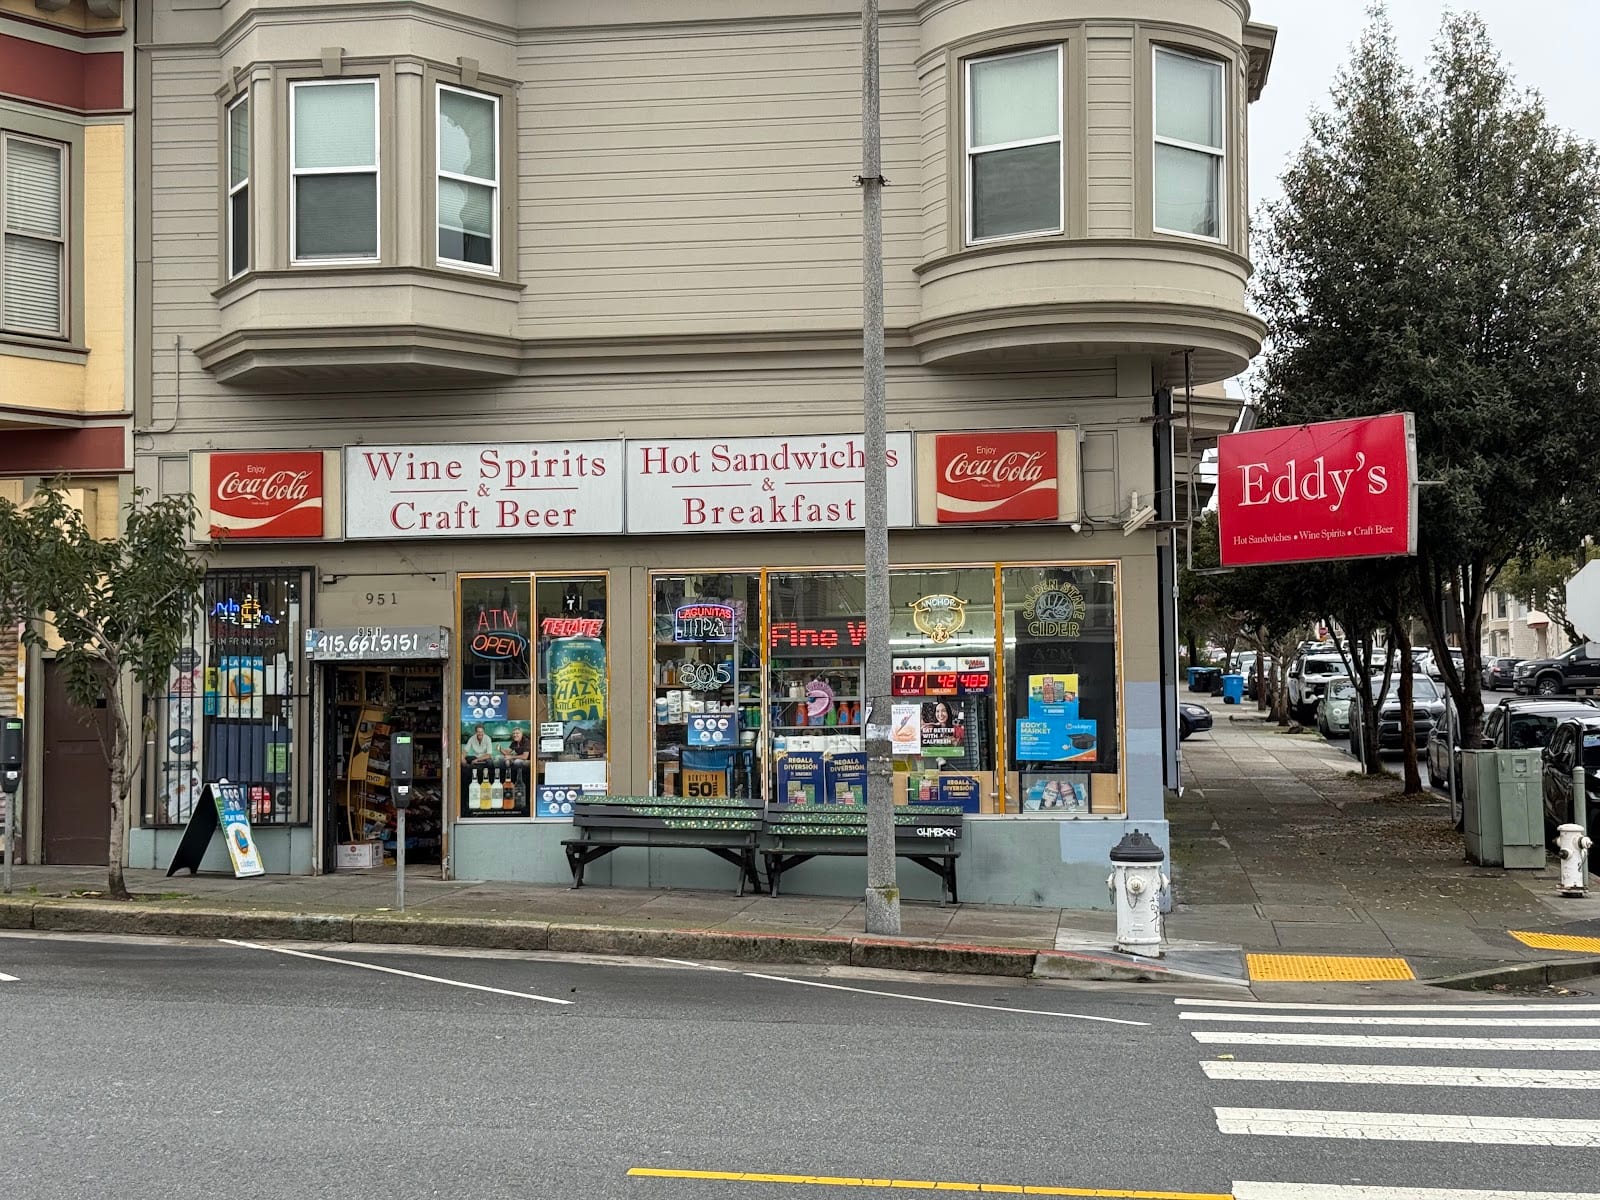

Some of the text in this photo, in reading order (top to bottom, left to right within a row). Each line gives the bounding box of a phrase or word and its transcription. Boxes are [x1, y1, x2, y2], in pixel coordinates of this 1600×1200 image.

[639, 441, 898, 475] Hot Sandwichs
[976, 446, 997, 455] Enjoy
[247, 465, 266, 474] Enjoy
[362, 449, 607, 488] Wine Spirits
[945, 451, 1047, 483] Coca-Cola
[218, 470, 313, 501] Coca-Cola
[477, 483, 490, 497] &
[762, 477, 776, 491] &
[1237, 451, 1388, 512] Eddy's
[390, 500, 577, 531] Craft Beer
[682, 494, 856, 526] Breakfast
[1233, 524, 1394, 545] Hot Sandwiches Wine Spirits Craft Beer
[366, 592, 398, 606] 951
[1023, 579, 1086, 621] GOLDEN STATE
[478, 609, 519, 631] ATM
[679, 608, 731, 619] LAGUNITAS
[540, 617, 605, 638] TECATE
[771, 622, 838, 648] Fine
[1028, 621, 1080, 637] CIDER
[318, 634, 418, 654] 415.661.5151
[473, 634, 522, 657] OPEN
[680, 664, 731, 684] 805
[901, 675, 924, 688] 171
[938, 675, 956, 687] 42
[961, 674, 988, 687] 489
[557, 680, 599, 700] HAZY
[556, 696, 601, 709] LITTLE THING
[688, 782, 712, 797] 50
